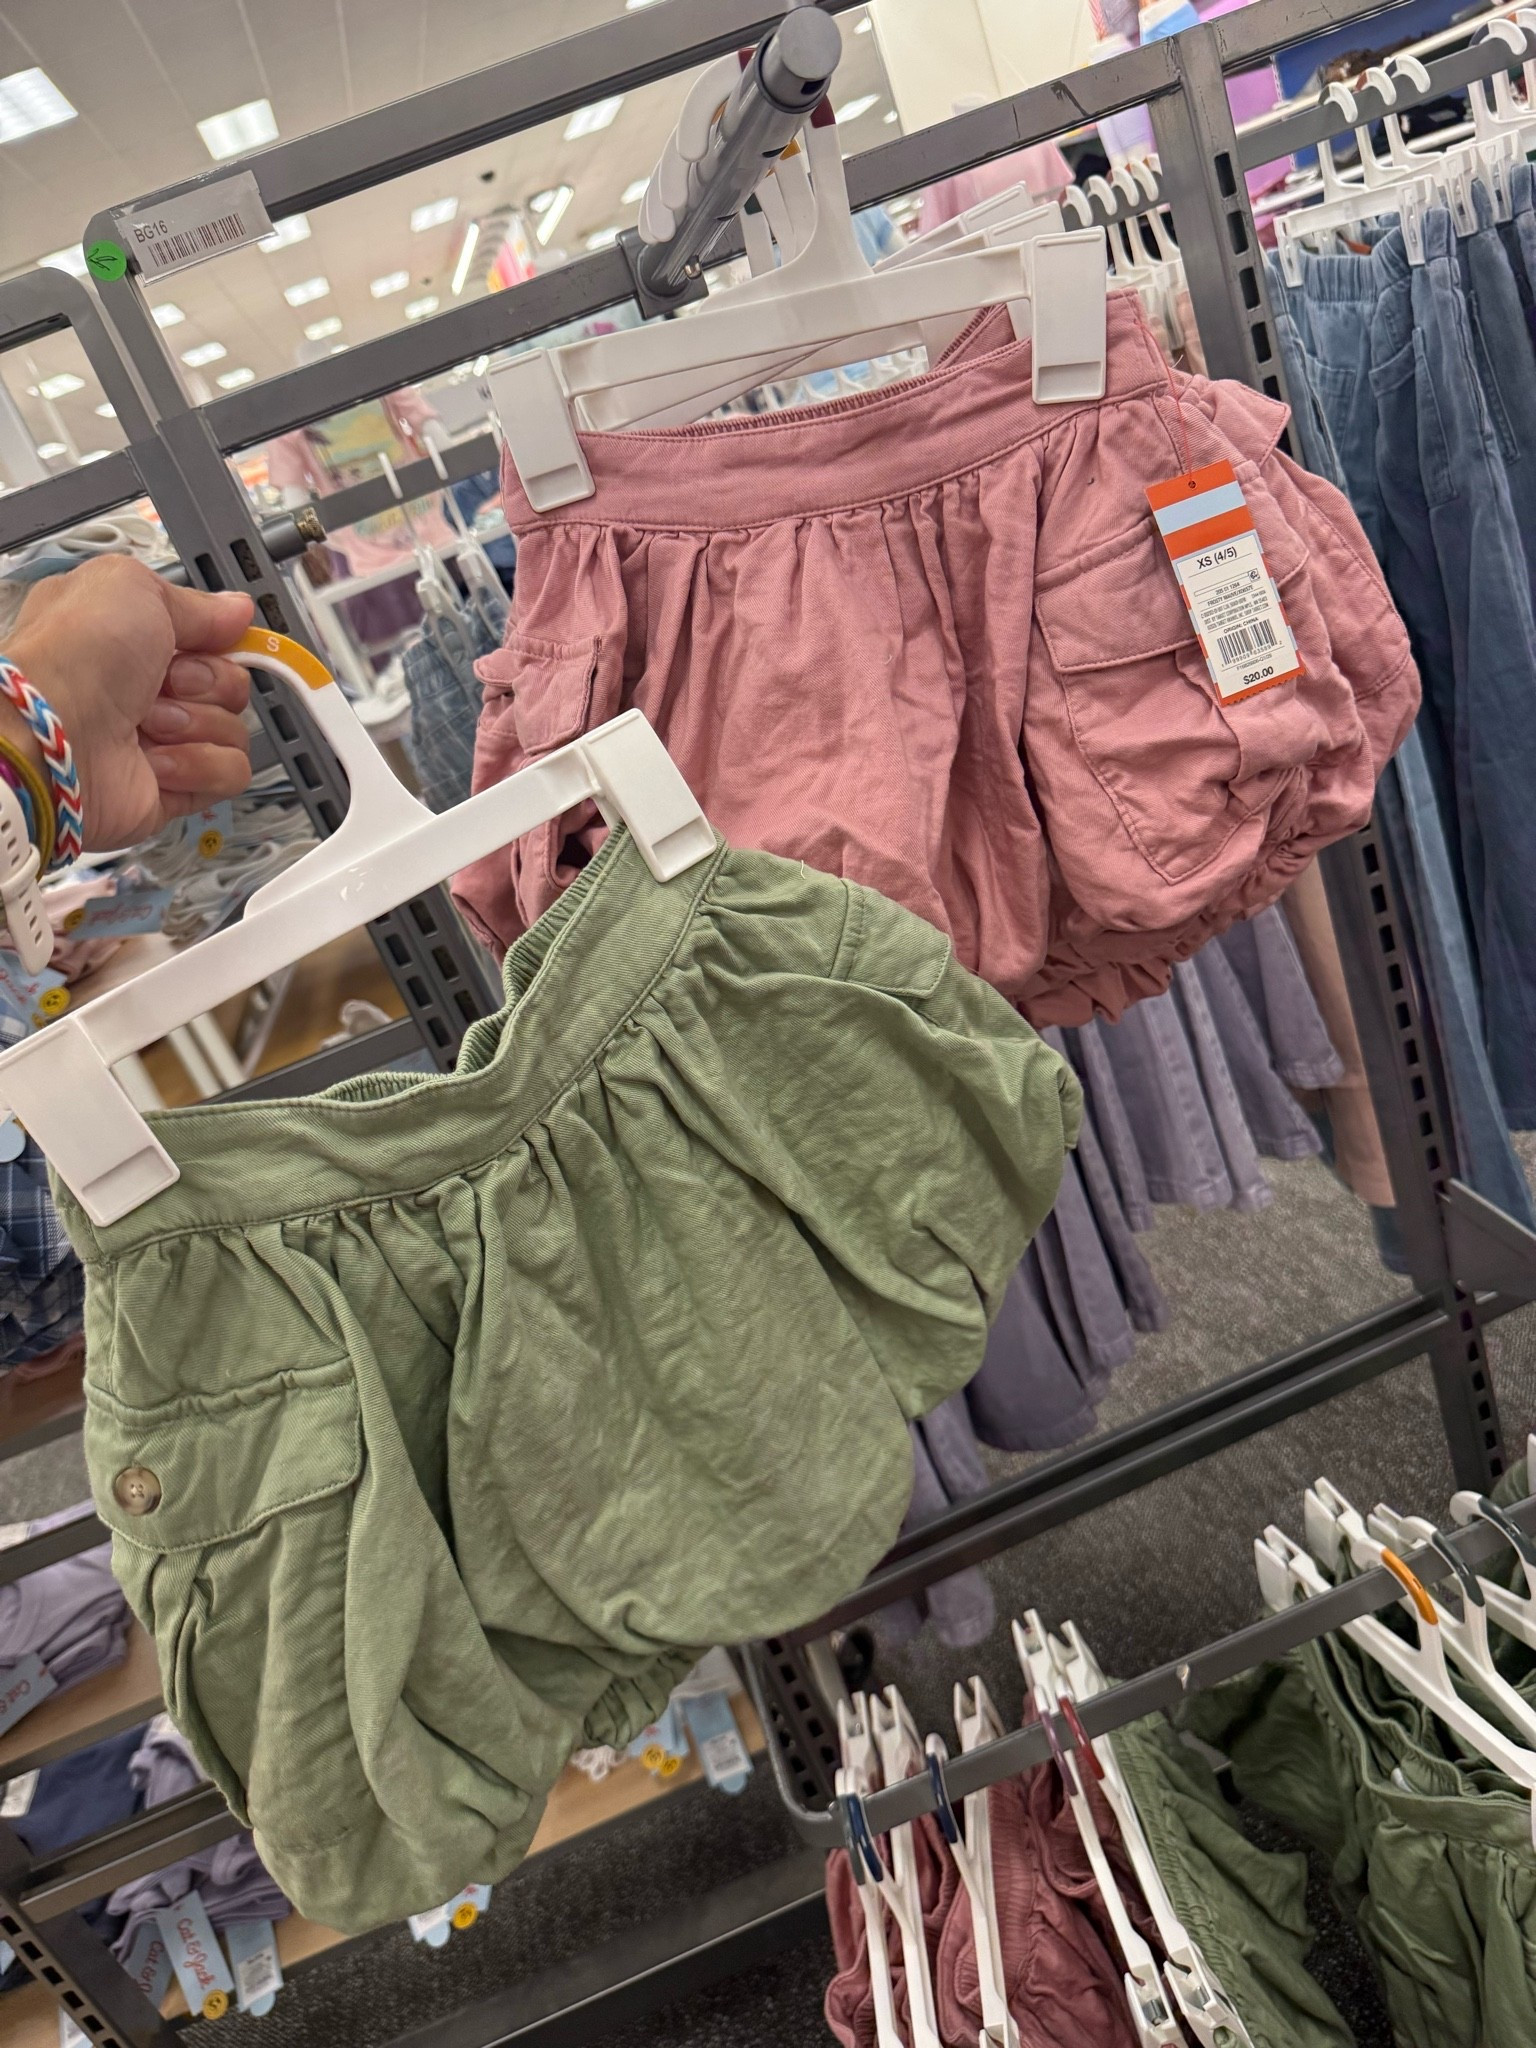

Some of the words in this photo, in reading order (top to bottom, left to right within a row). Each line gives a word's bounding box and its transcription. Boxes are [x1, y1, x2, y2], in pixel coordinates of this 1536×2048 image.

[133, 220, 168, 243] BG16
[1196, 556, 1213, 569] XS
[1214, 546, 1237, 565] (4/5)
[266, 636, 280, 653] S
[1243, 666, 1274, 685] $20.00
